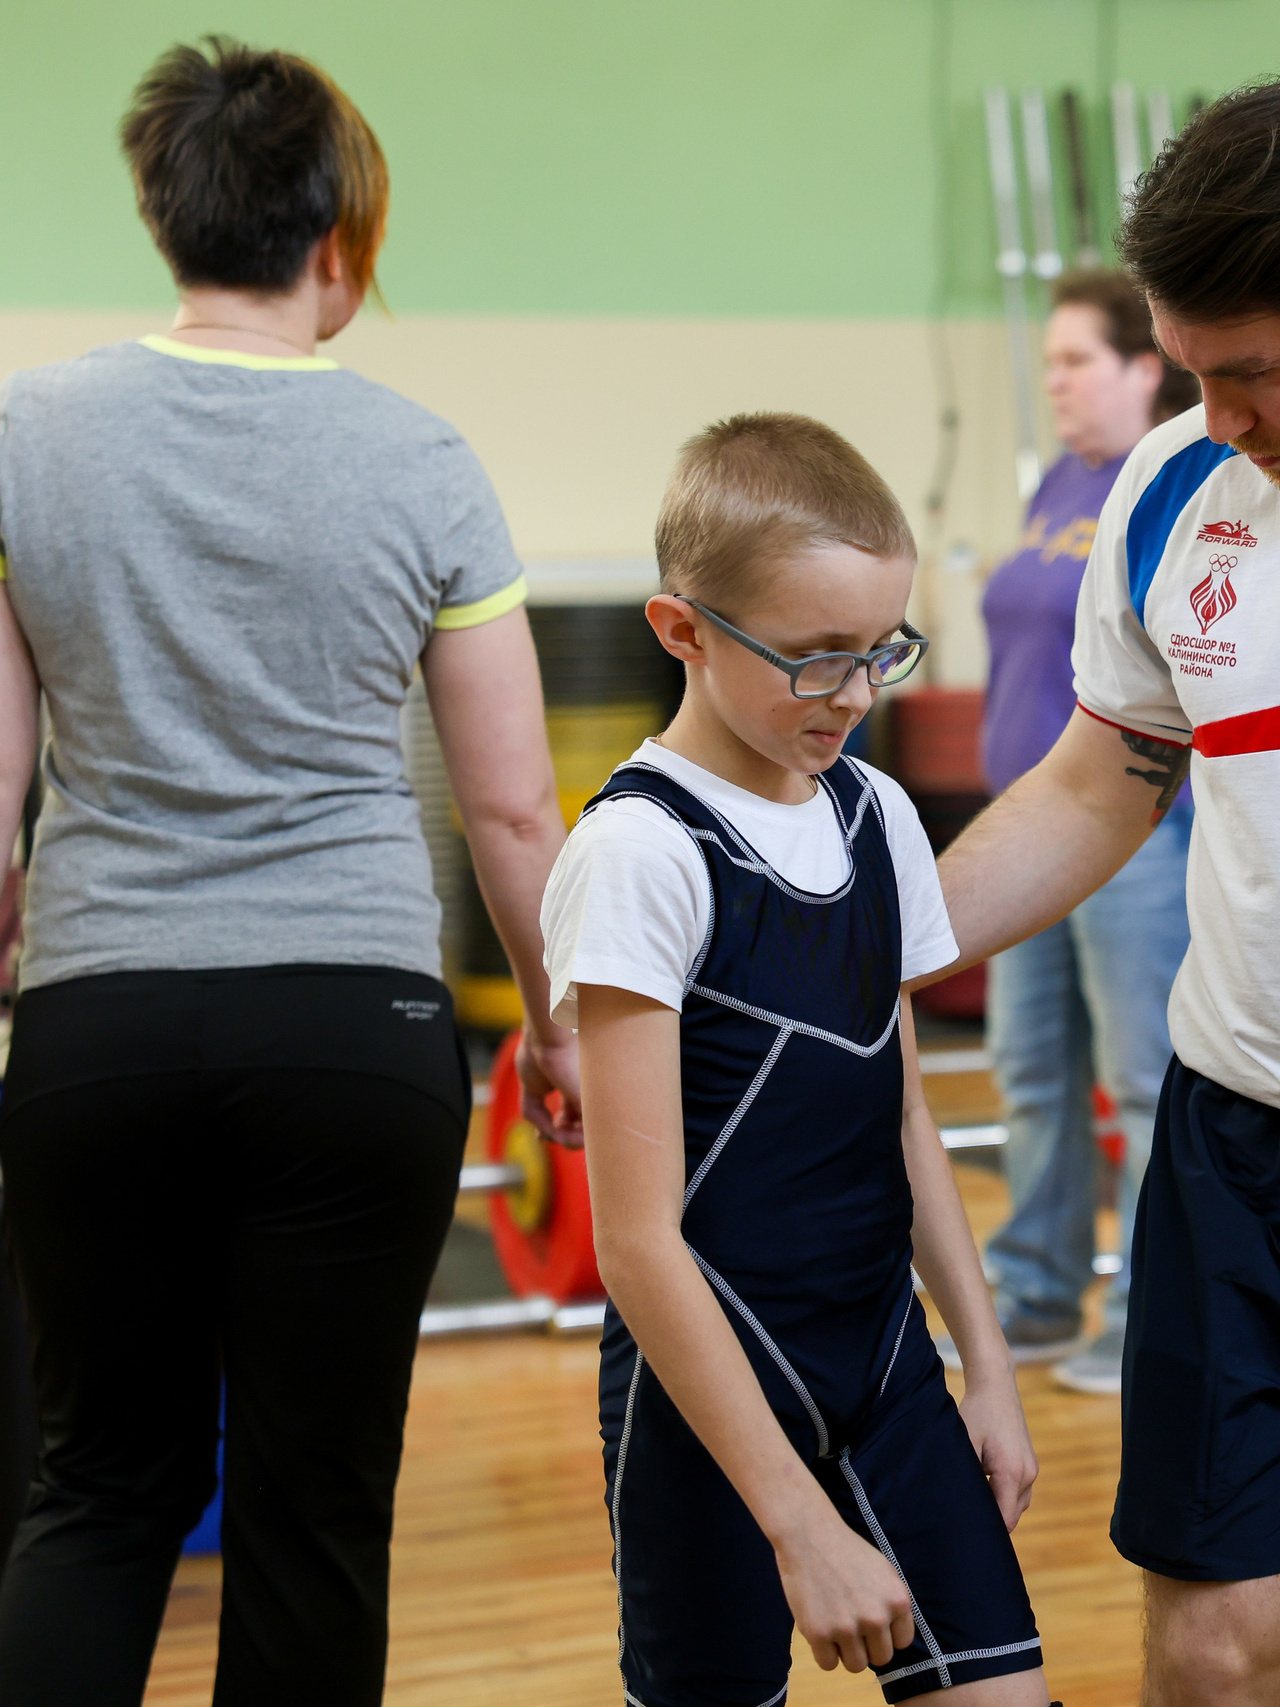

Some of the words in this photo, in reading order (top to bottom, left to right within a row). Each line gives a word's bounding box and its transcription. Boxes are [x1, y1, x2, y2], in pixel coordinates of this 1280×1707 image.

[1196, 533, 1258, 548] FORWARD
[1170, 633, 1217, 651] СДЮСШОР
[1167, 646, 1237, 667] КАЛИНИНСКОГО
[1179, 662, 1213, 678] РАЙОНА
